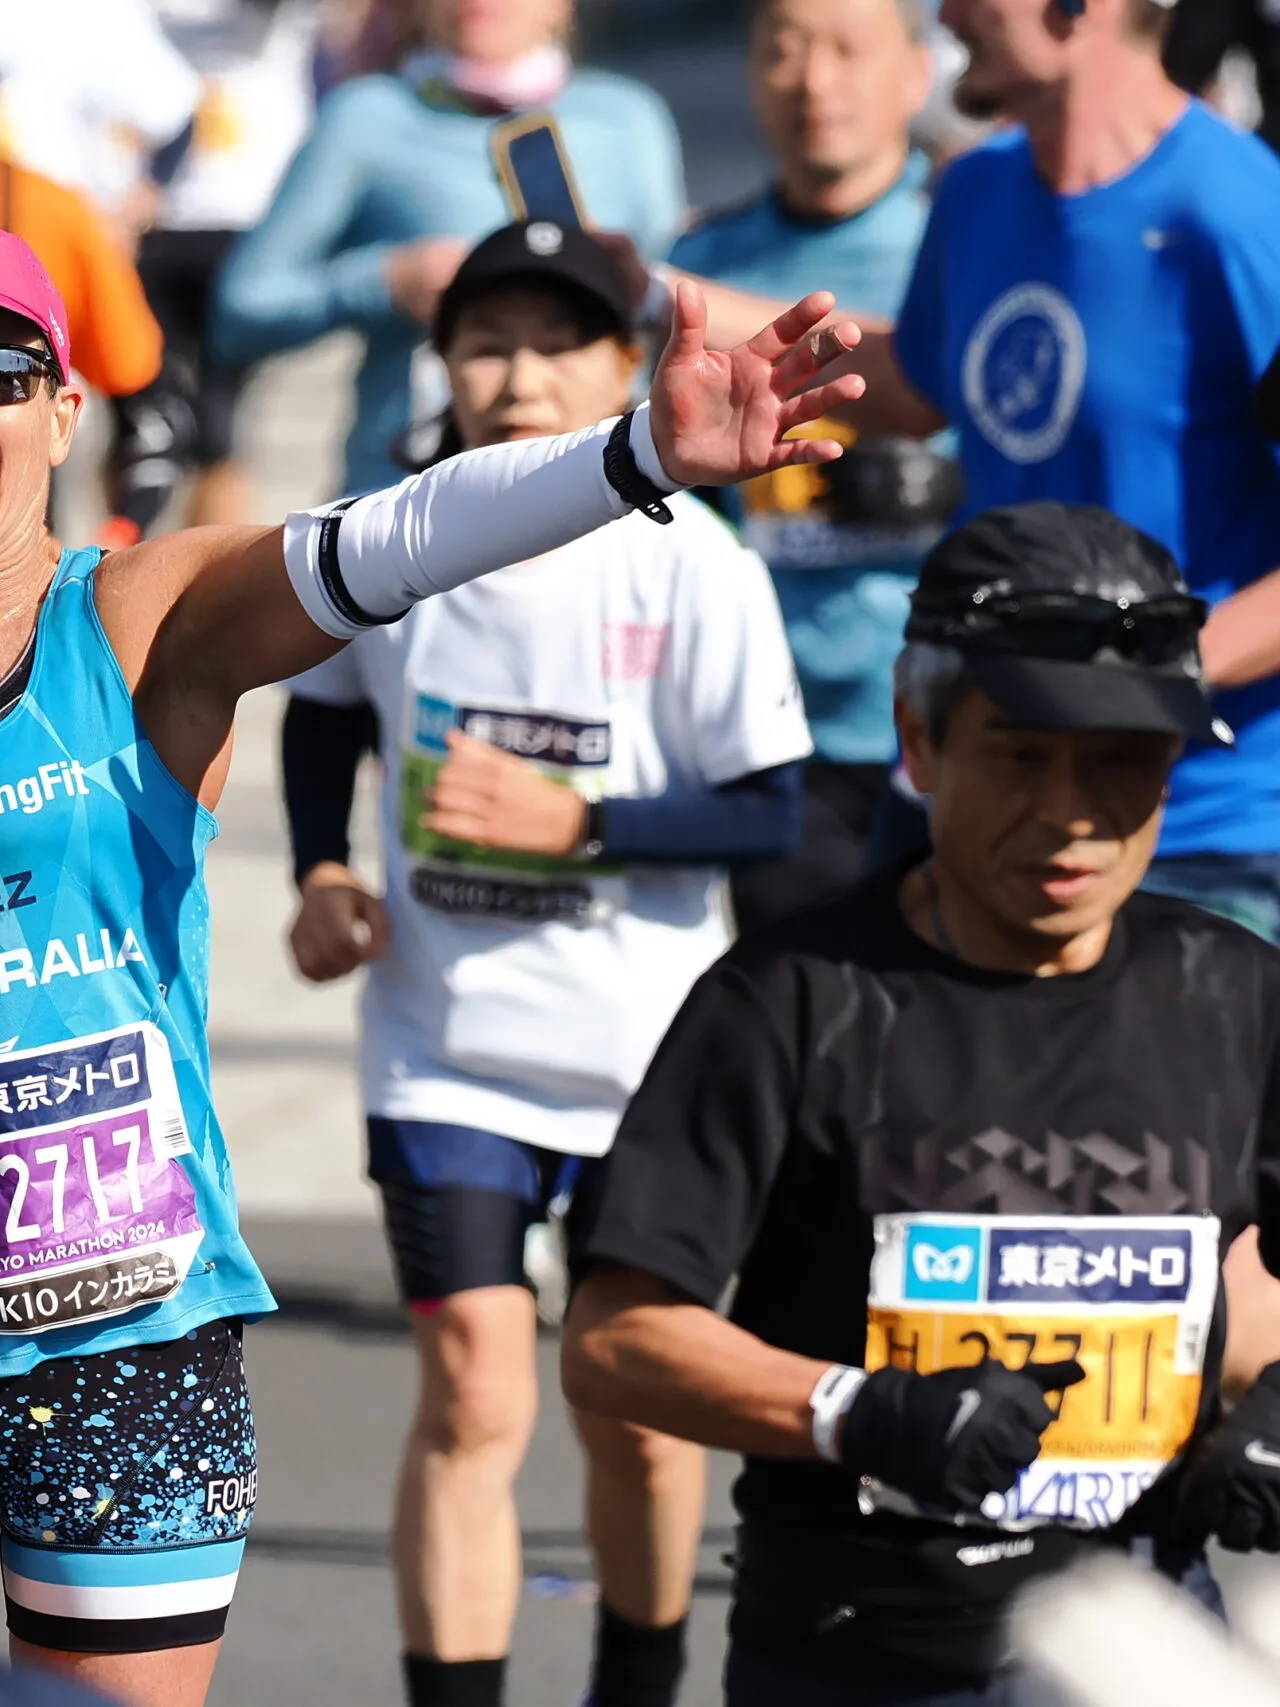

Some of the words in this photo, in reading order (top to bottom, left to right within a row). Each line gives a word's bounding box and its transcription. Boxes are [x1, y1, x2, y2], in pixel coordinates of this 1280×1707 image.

[28, 1230, 126, 1266] MARATHON
[127, 1220, 166, 1243] 2024
[997, 1244, 1186, 1288] 東京メトロ
[63, 1262, 174, 1310] インカラミ
